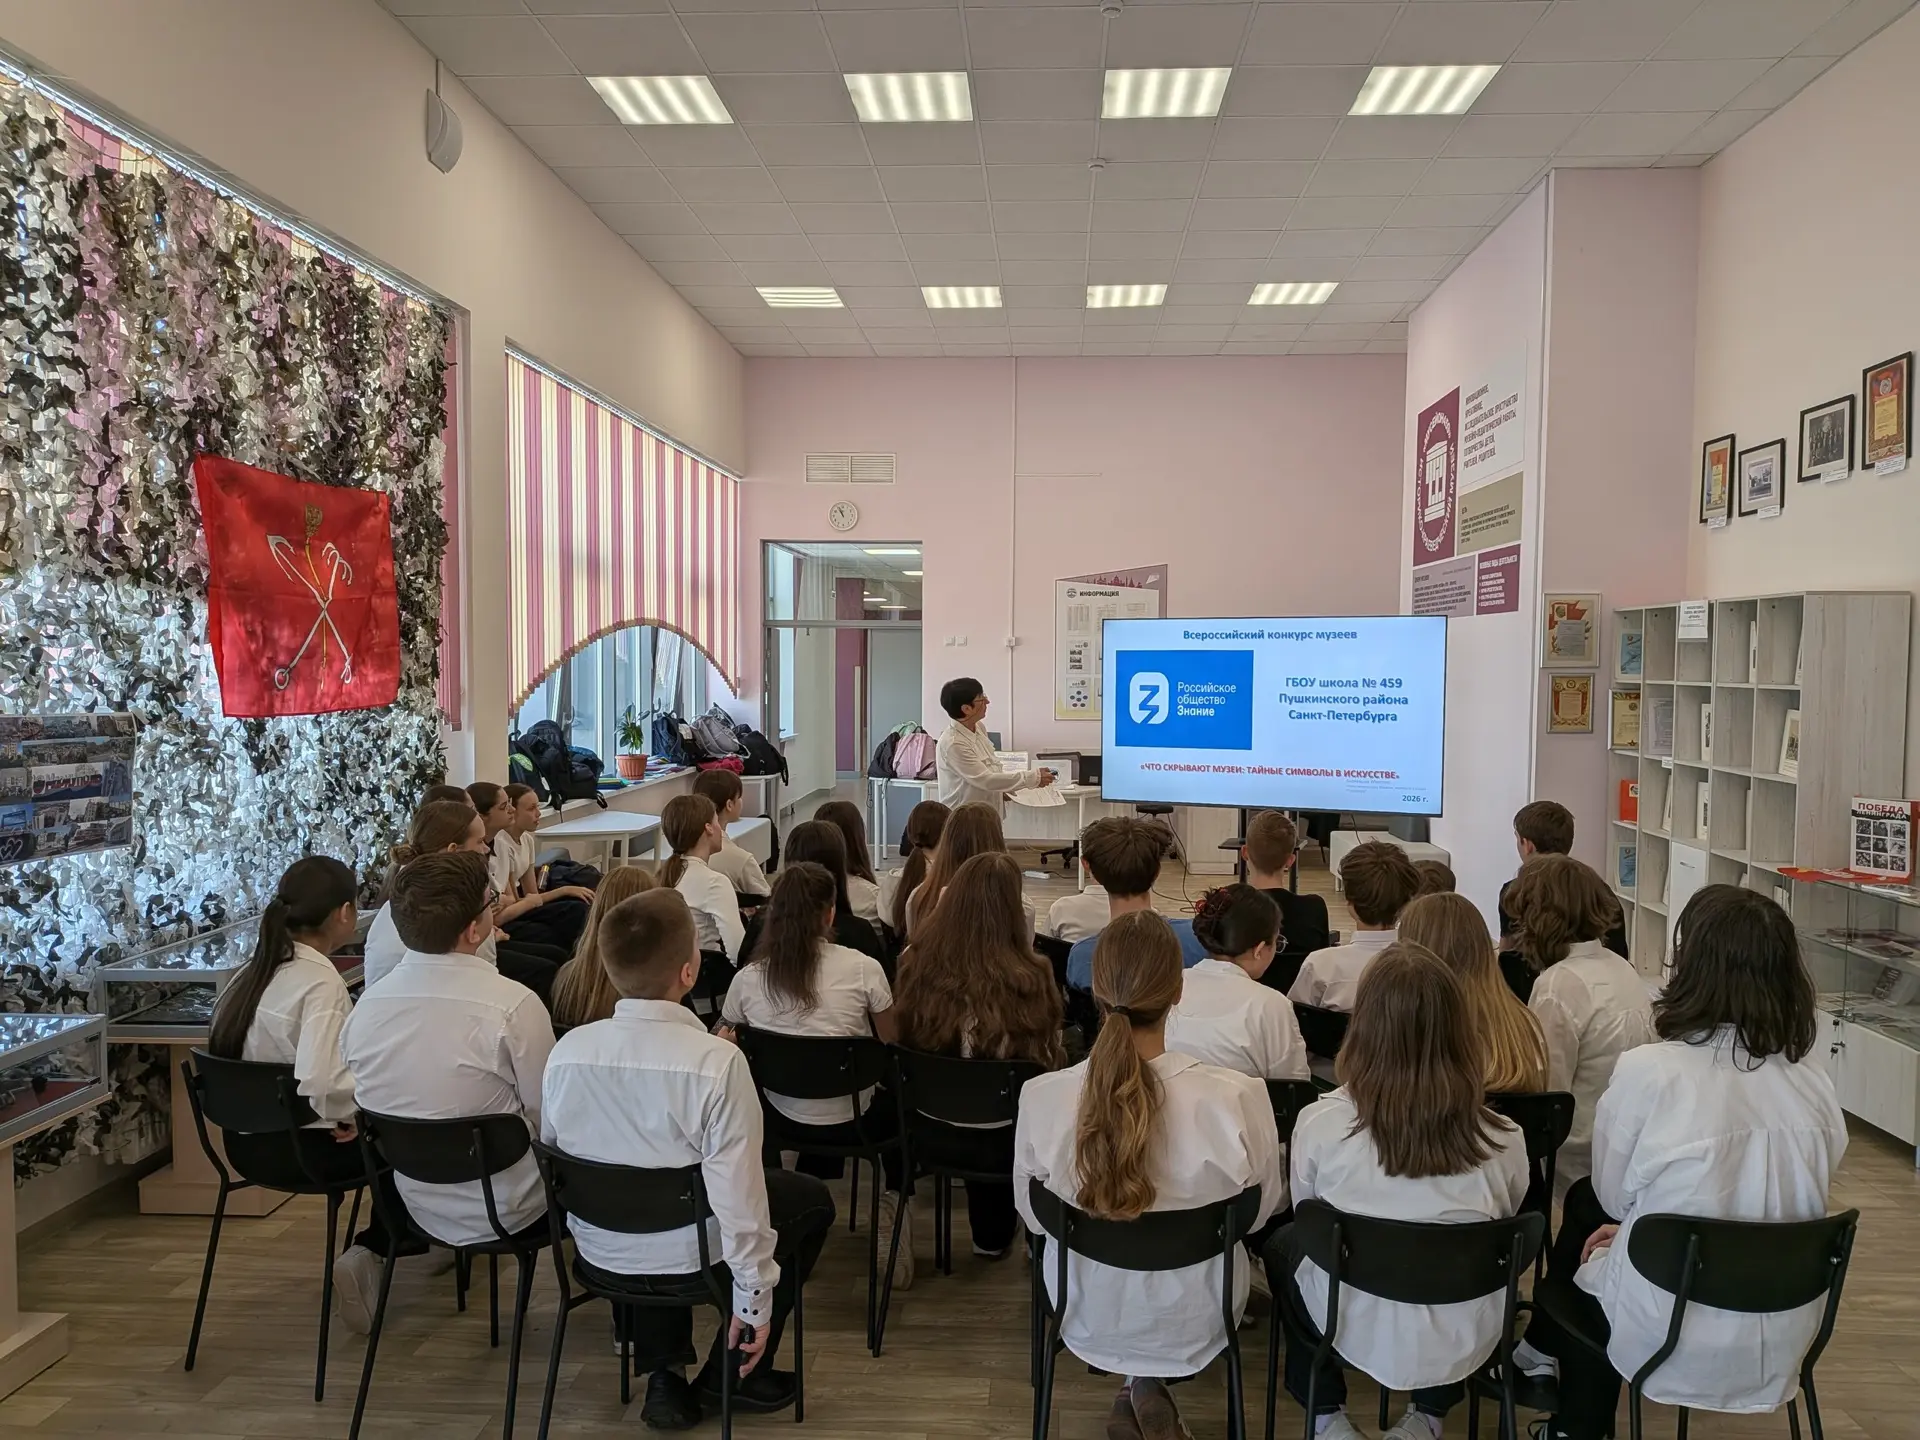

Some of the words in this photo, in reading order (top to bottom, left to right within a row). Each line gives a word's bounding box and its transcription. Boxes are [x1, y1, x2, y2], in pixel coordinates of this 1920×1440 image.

[1183, 629, 1265, 641] Всероссийский
[1268, 630, 1313, 641] конкурс
[1316, 630, 1357, 641] музеев
[1177, 681, 1237, 693] Российское
[1285, 677, 1316, 688] ГБОУ
[1319, 678, 1359, 688] школа
[1362, 677, 1377, 688] №
[1379, 677, 1403, 688] 459
[1177, 693, 1226, 706] общество
[1279, 693, 1360, 705] Пушкинского
[1362, 694, 1409, 706] района
[1177, 705, 1215, 716] Знание
[1288, 709, 1398, 723] Санкт-Петербурга
[1140, 763, 1161, 771] «ЧТО
[1163, 763, 1211, 772] СКРЫВАЮТ
[1212, 765, 1245, 774] МУЗЕИ:
[1247, 765, 1283, 775] ТАЙНЫЕ
[1285, 767, 1334, 777] СИМВОЛЫ
[1335, 769, 1342, 777] В
[1858, 802, 1905, 815] ПОБЕДА
[1857, 811, 1907, 819] ЛЕНИНГРАДА
